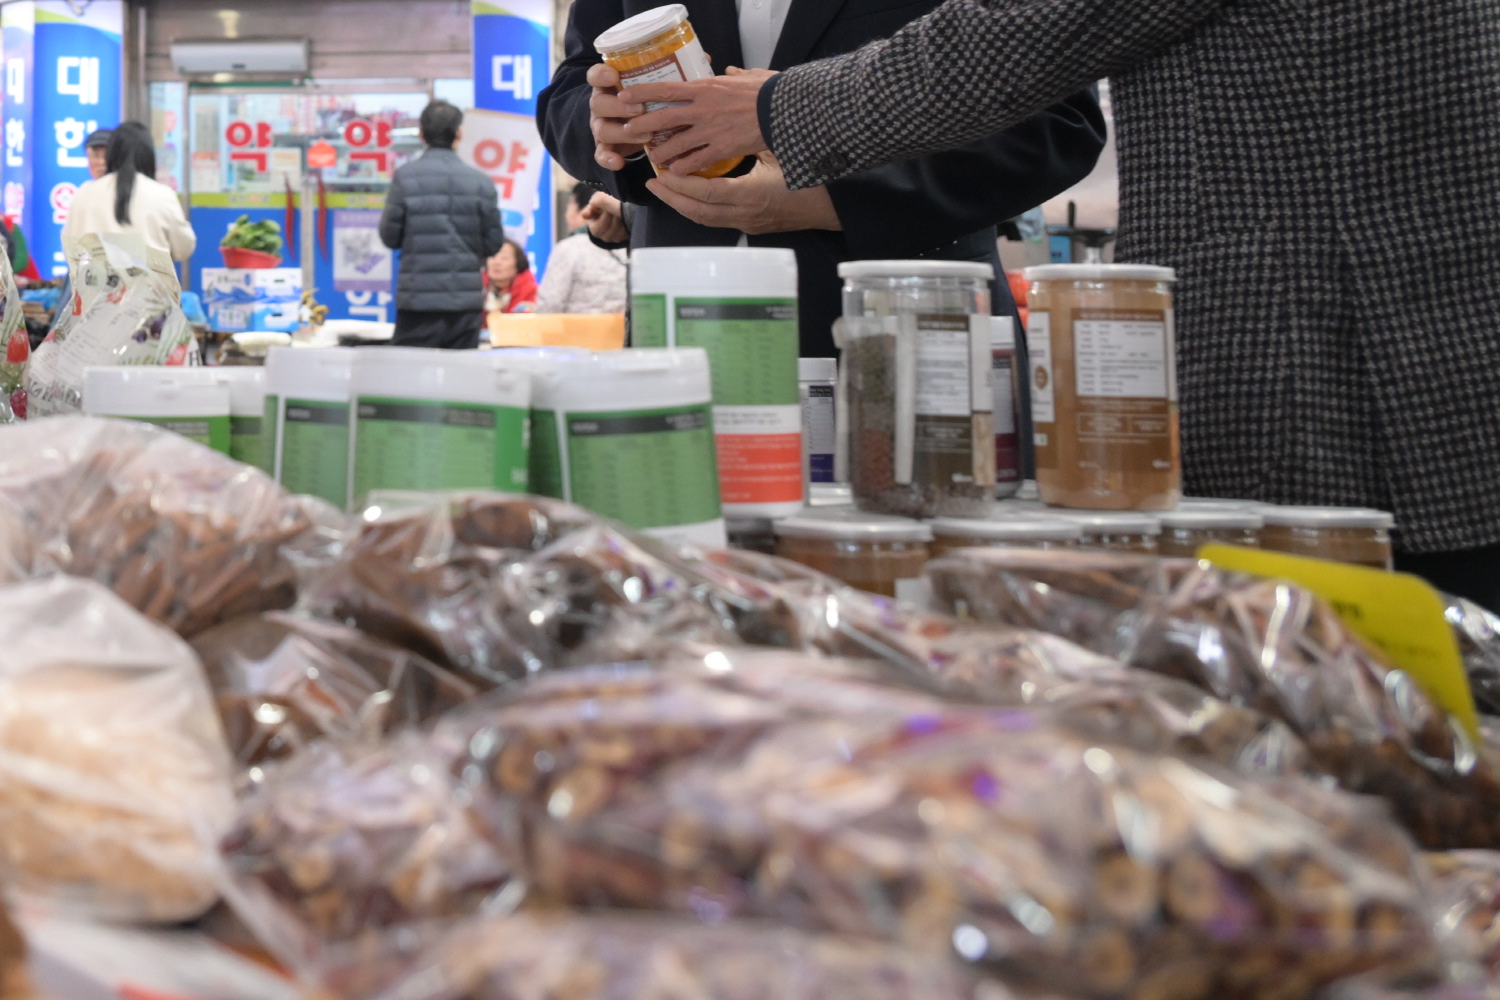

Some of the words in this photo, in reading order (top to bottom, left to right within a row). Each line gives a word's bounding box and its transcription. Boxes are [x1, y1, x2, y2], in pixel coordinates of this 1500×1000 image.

[226, 121, 274, 174] 약
[345, 120, 393, 173] 약
[472, 138, 530, 200] 약
